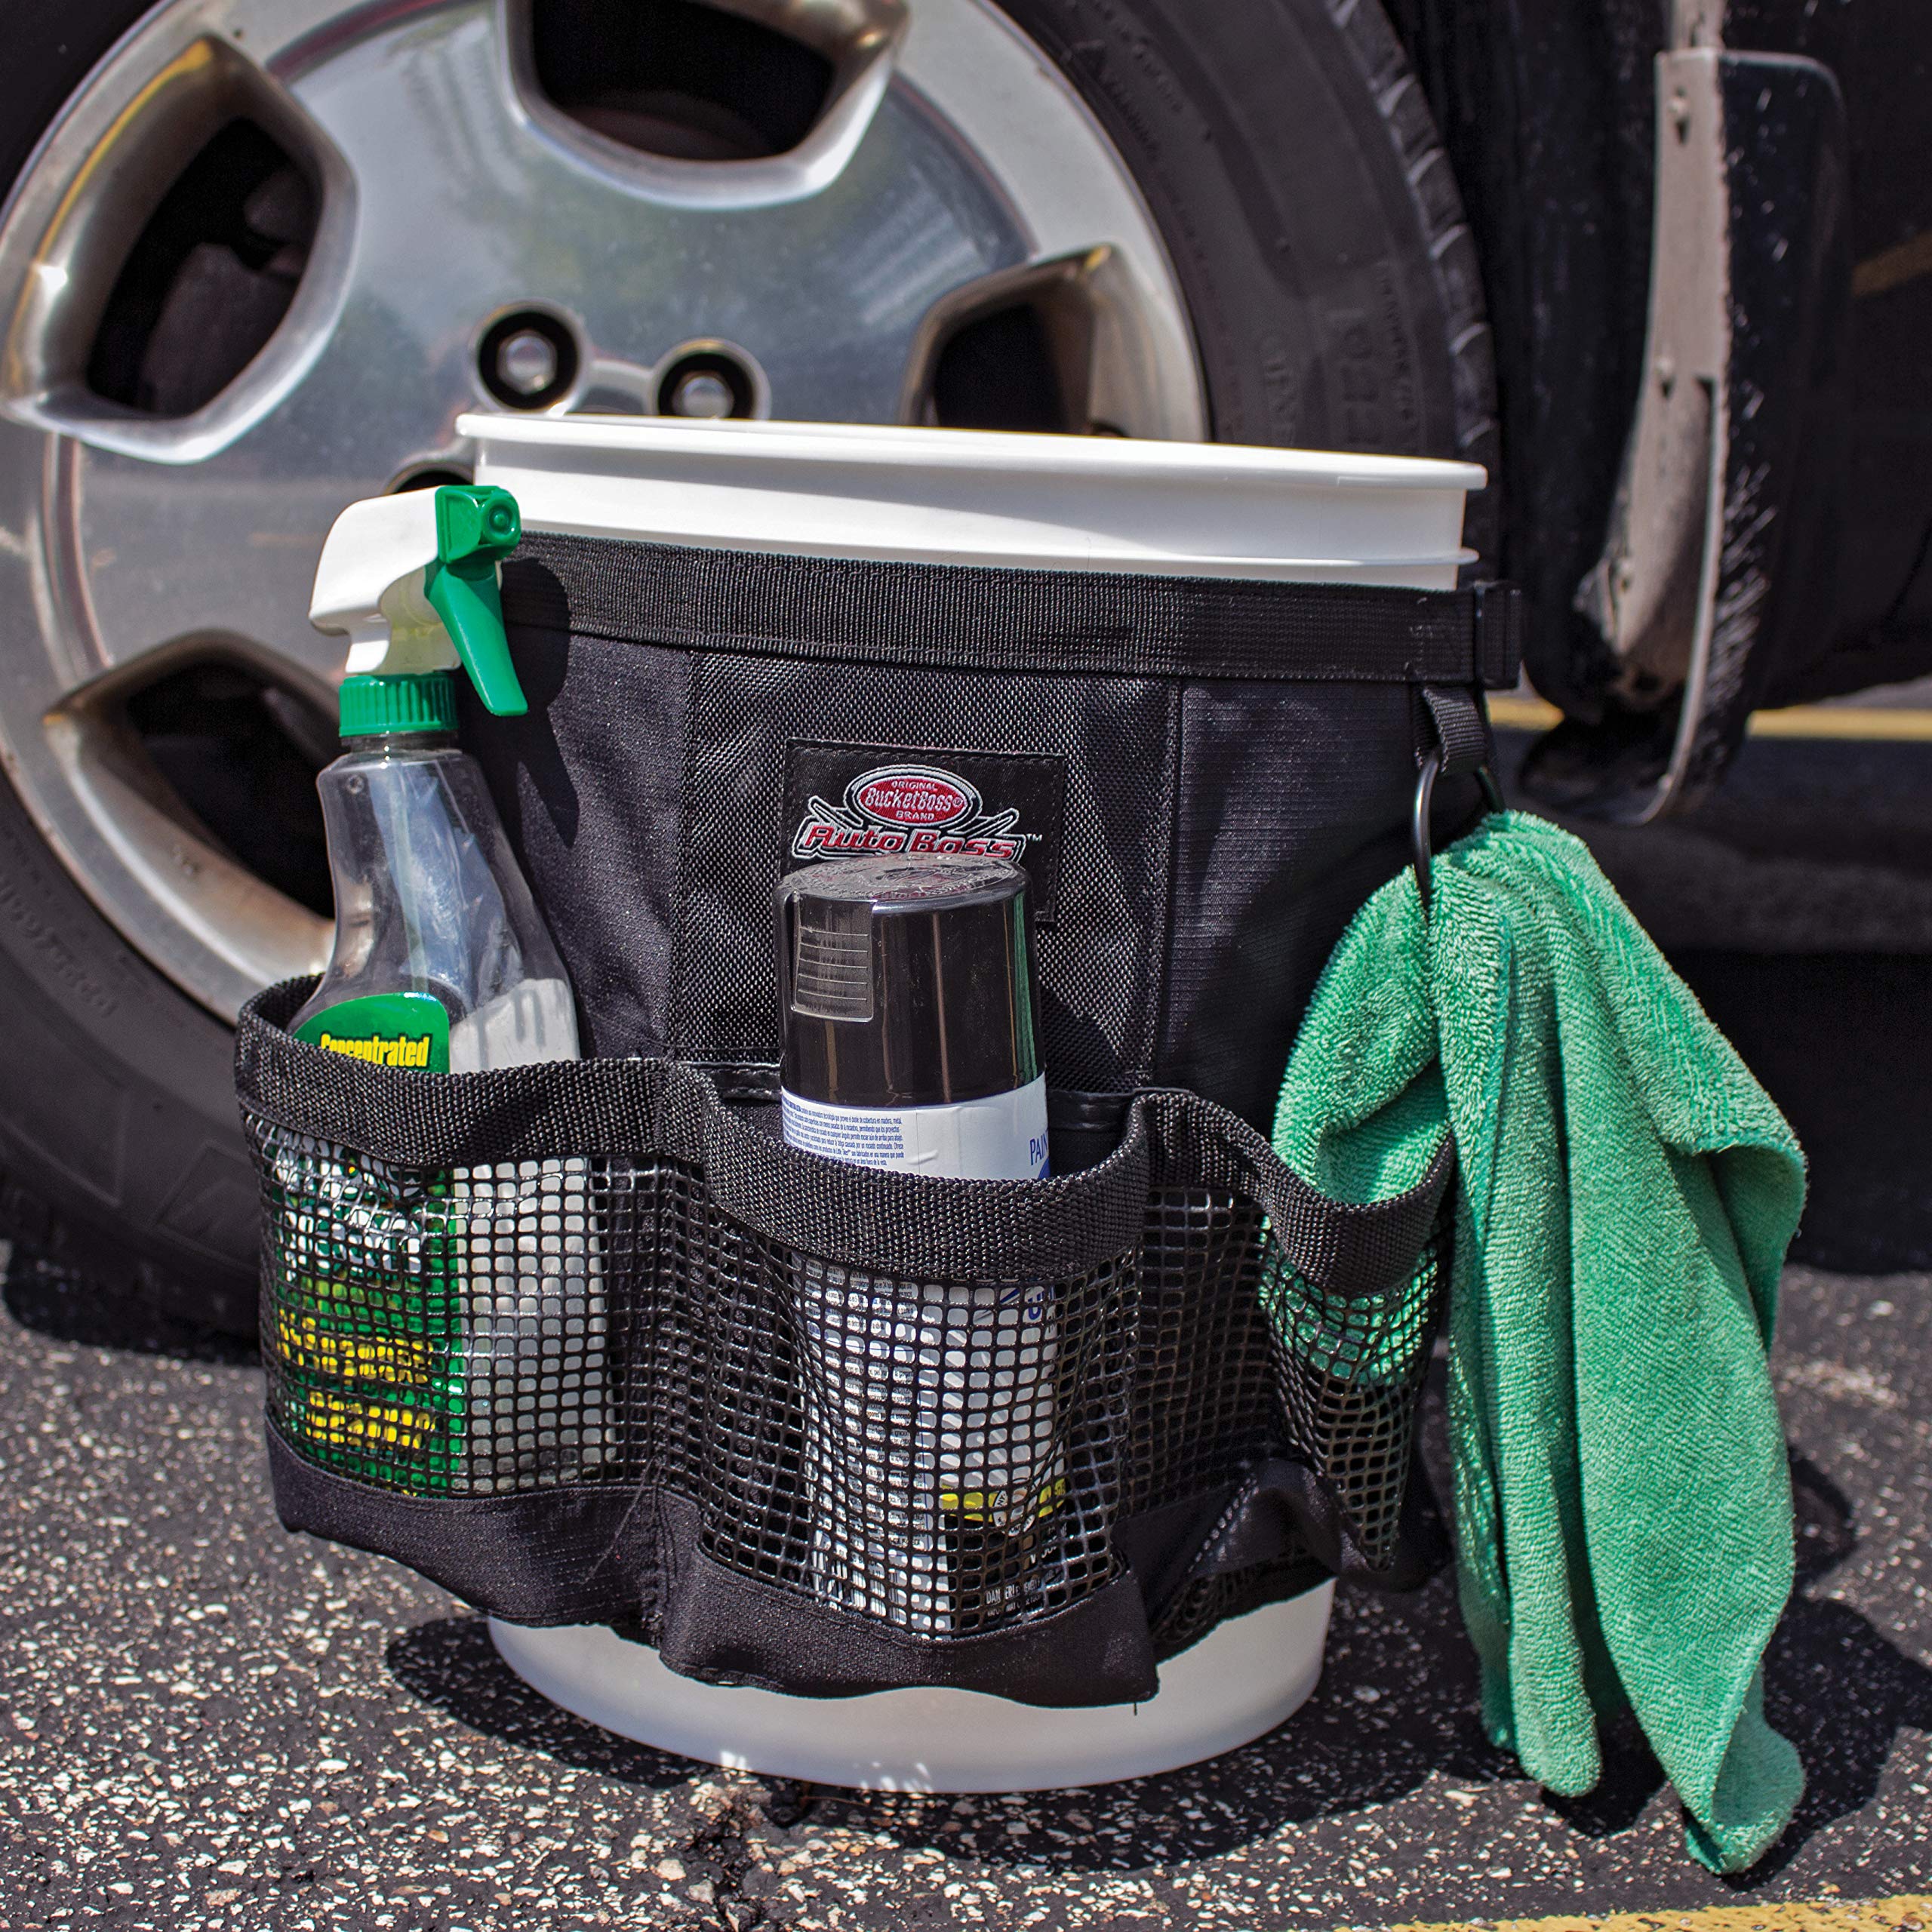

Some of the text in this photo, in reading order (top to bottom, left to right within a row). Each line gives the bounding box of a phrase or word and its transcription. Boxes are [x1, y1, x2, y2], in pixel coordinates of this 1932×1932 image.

[891, 780, 938, 792] ORIGINAL
[896, 811, 934, 820] BRAND
[803, 824, 903, 851] Auto
[910, 831, 1017, 858] Boss
